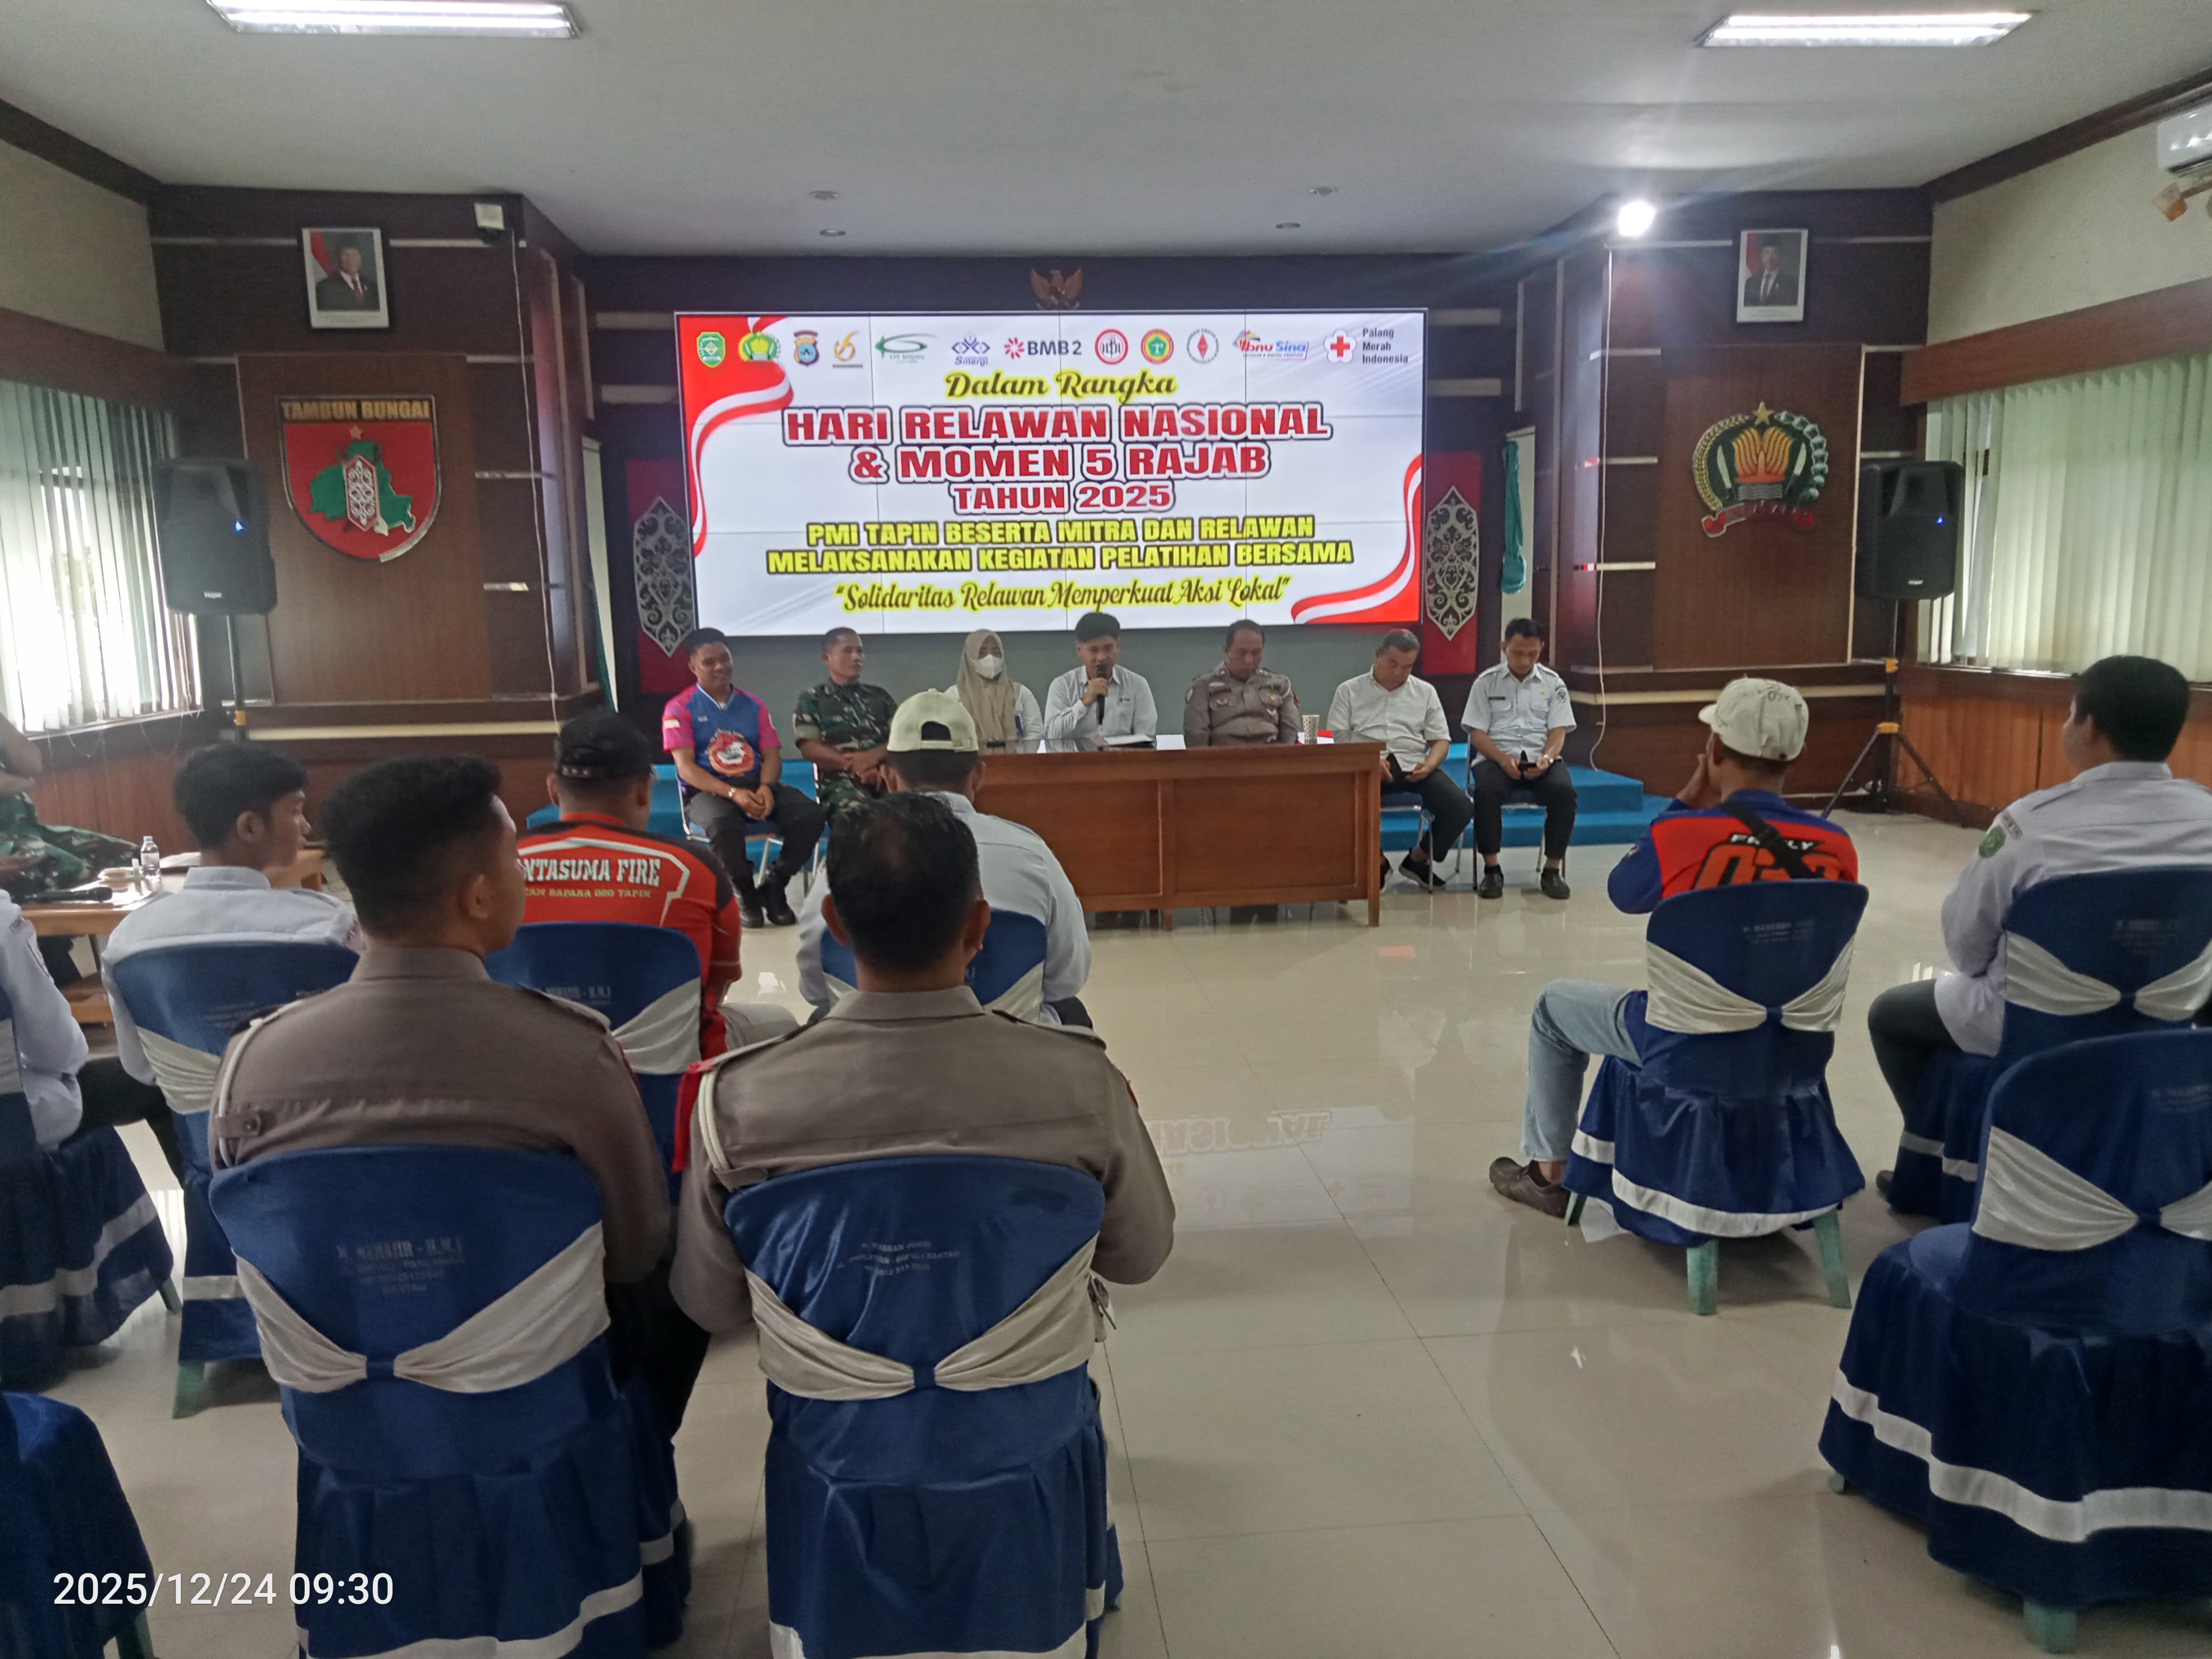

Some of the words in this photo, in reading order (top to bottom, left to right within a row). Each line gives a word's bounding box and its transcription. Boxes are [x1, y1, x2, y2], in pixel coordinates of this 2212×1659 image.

[1241, 339, 1273, 352] Ibnu
[1276, 340, 1306, 352] Sina
[1362, 326, 1394, 340] Palang
[1028, 340, 1069, 356] BMB
[1072, 340, 1083, 355] 2
[1362, 341, 1392, 351] Merah
[1362, 353, 1409, 364] Indonesia
[955, 355, 988, 367] Sinergi
[945, 371, 1049, 397] Dalam
[1056, 370, 1176, 403] Rangka
[281, 400, 358, 421] TAMBUN
[787, 412, 888, 441] HARI
[904, 410, 1107, 439] RELAWAN
[1124, 408, 1328, 437] NASIONAL
[853, 451, 883, 479] &
[900, 449, 1073, 478] MOMEN
[1086, 449, 1113, 475] 5
[1129, 446, 1266, 476] RAJAB
[953, 486, 1068, 509] TAHUN
[1078, 484, 1171, 508] 2025
[808, 524, 859, 546] PMI
[865, 523, 938, 544] TAPIN
[944, 521, 1049, 544] BESERTA
[1057, 519, 1137, 542] MITRA
[1143, 517, 1193, 541] DAN
[1200, 515, 1315, 540] RELAWAN
[766, 549, 972, 574] MELAKSANAKAN
[978, 546, 1095, 572] KEGIATAN
[1100, 543, 1229, 569] PELATIHAN
[1235, 541, 1354, 566] BERSAMA
[961, 583, 1049, 610] Relawan
[1050, 580, 1174, 611] Memperkuat
[1176, 579, 1223, 604] Aksi
[616, 858, 661, 887] FIRE
